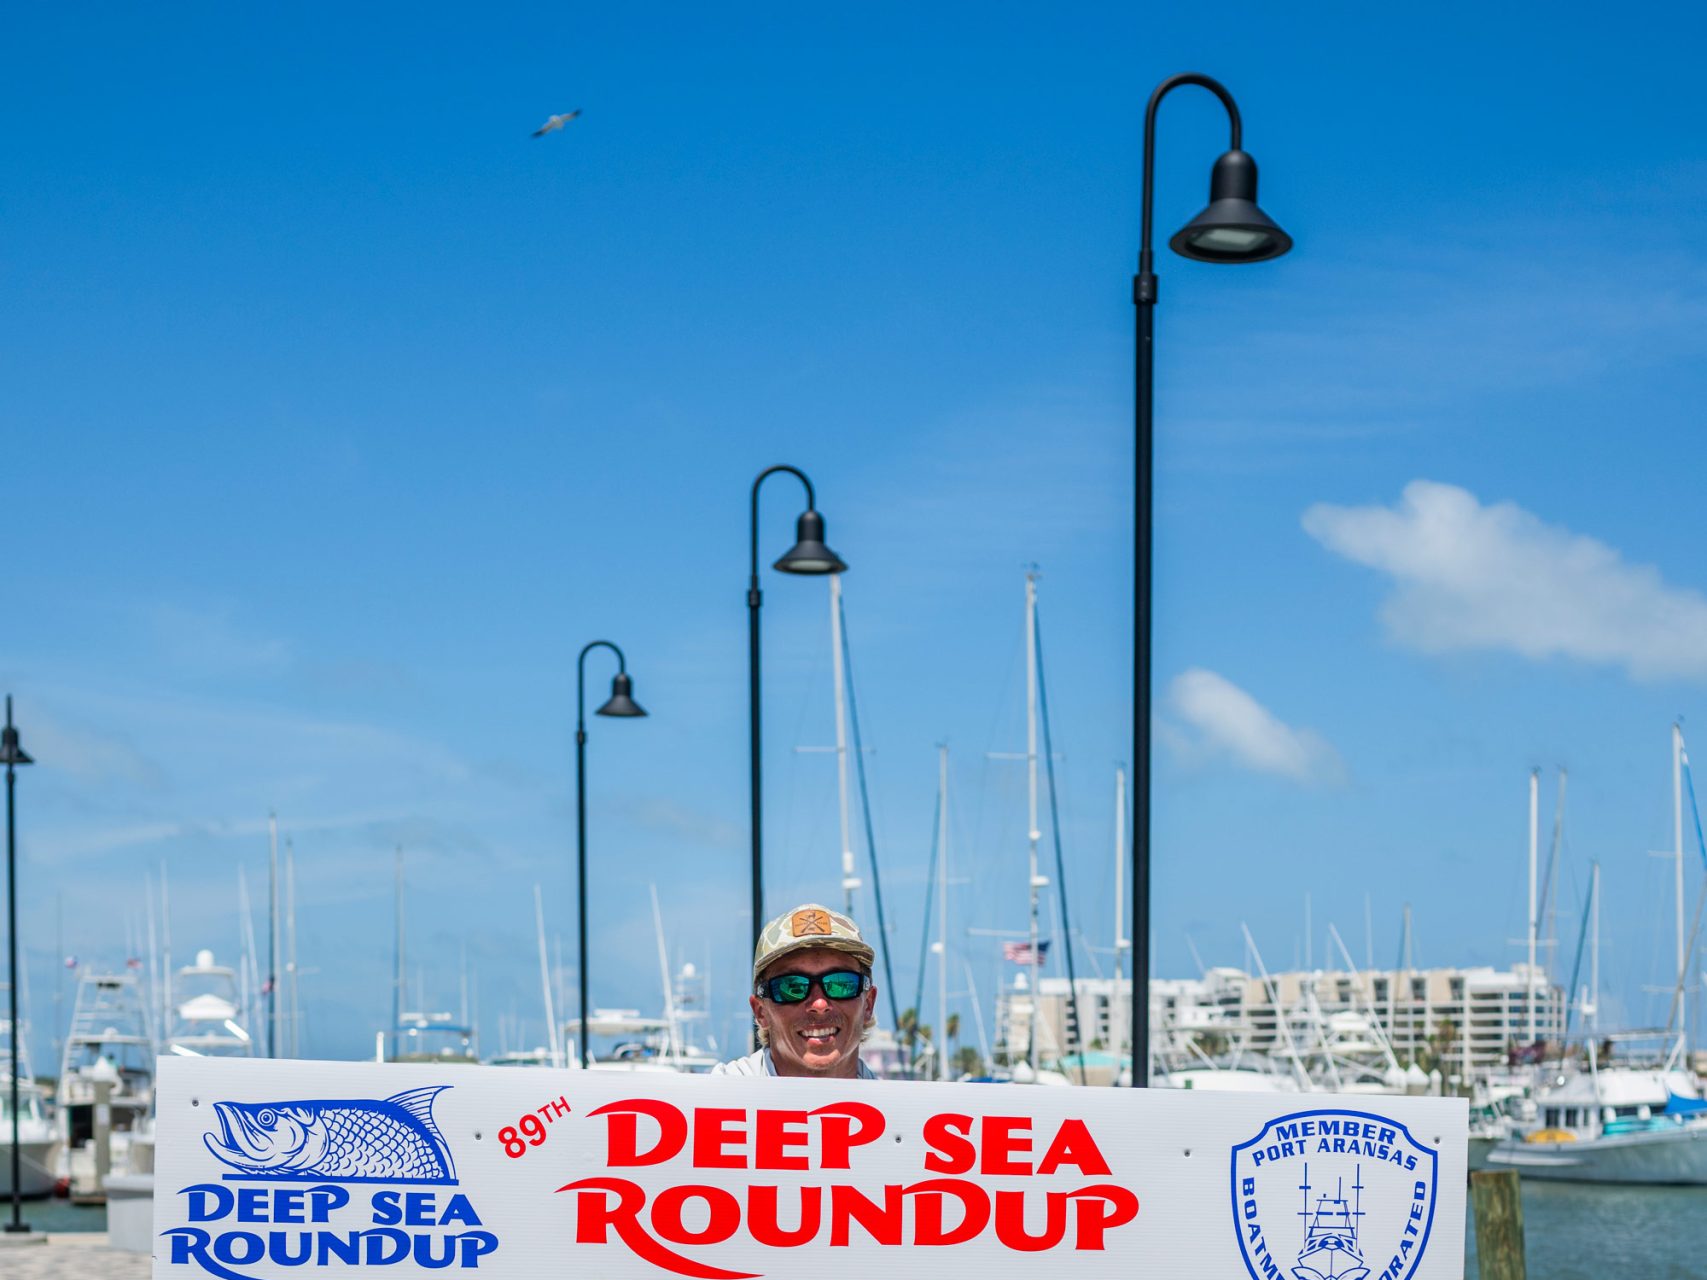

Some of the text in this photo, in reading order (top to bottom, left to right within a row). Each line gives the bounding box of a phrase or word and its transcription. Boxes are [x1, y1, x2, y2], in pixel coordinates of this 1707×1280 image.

[497, 1096, 572, 1160] 89TH
[587, 1099, 1112, 1177] DEEP SEA
[1252, 1138, 1418, 1171] PORT ARANSAS
[1275, 1120, 1397, 1146] MEMBER
[176, 1183, 484, 1227] DEEP SEA
[554, 1176, 1140, 1280] ROUNDUP
